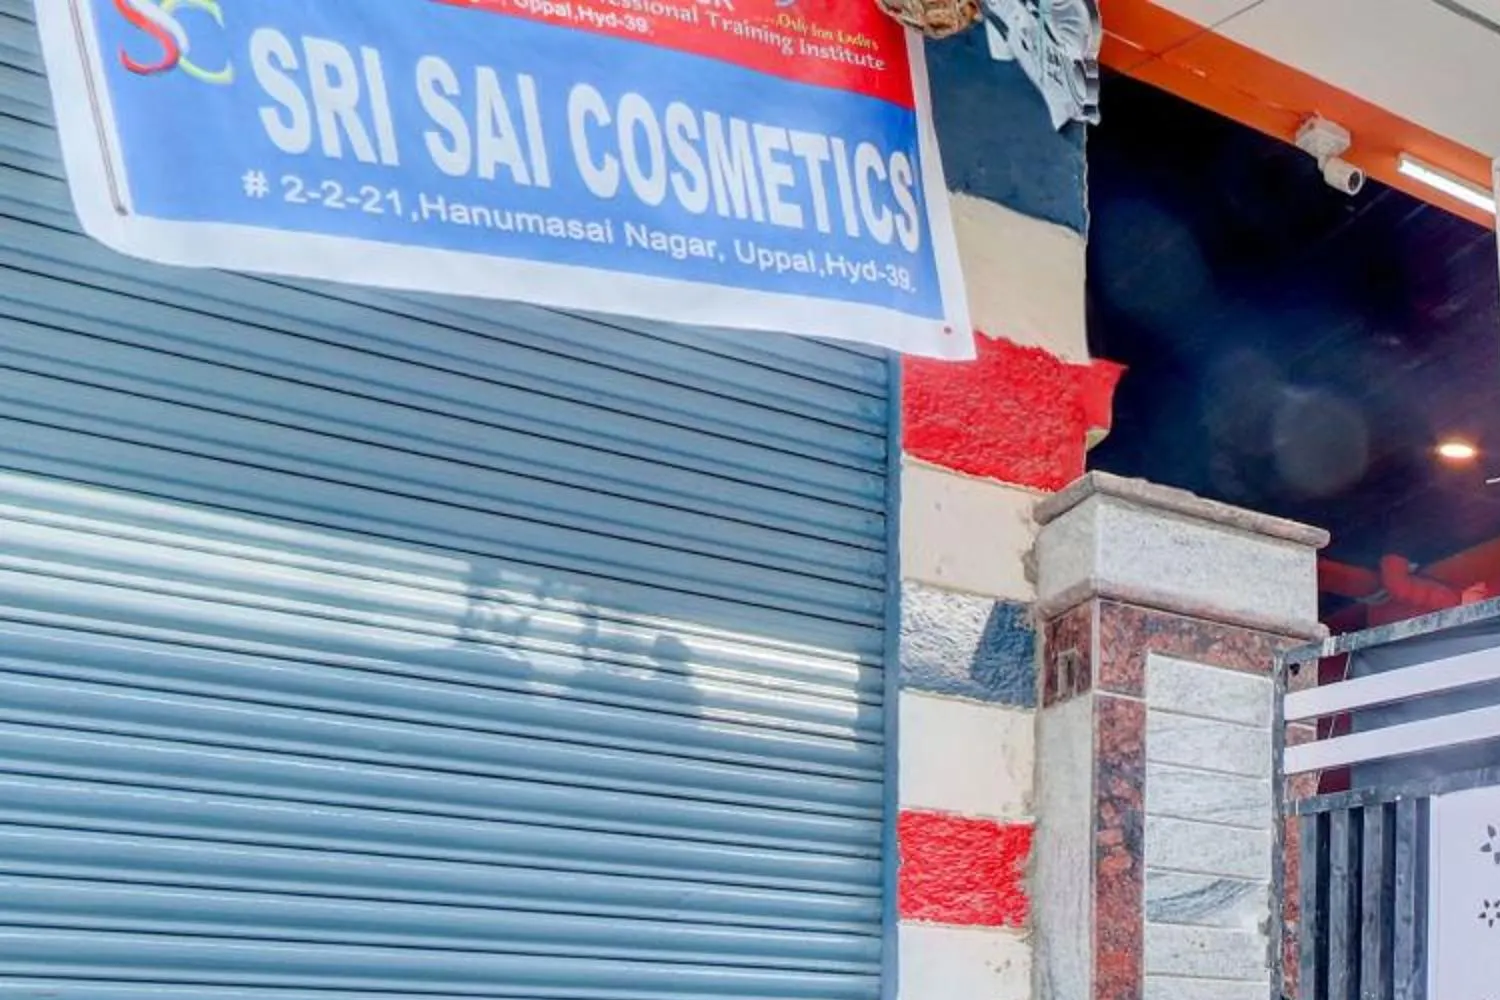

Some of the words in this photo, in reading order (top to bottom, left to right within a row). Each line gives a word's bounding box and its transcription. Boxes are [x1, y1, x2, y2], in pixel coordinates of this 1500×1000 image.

[607, 0, 699, 24] essional
[704, 11, 795, 56] Training
[799, 38, 887, 70] Institute
[248, 27, 400, 167] SRI
[414, 56, 550, 189] SAI
[568, 84, 920, 254] COSMETICS
[623, 221, 726, 264] Nagar,
